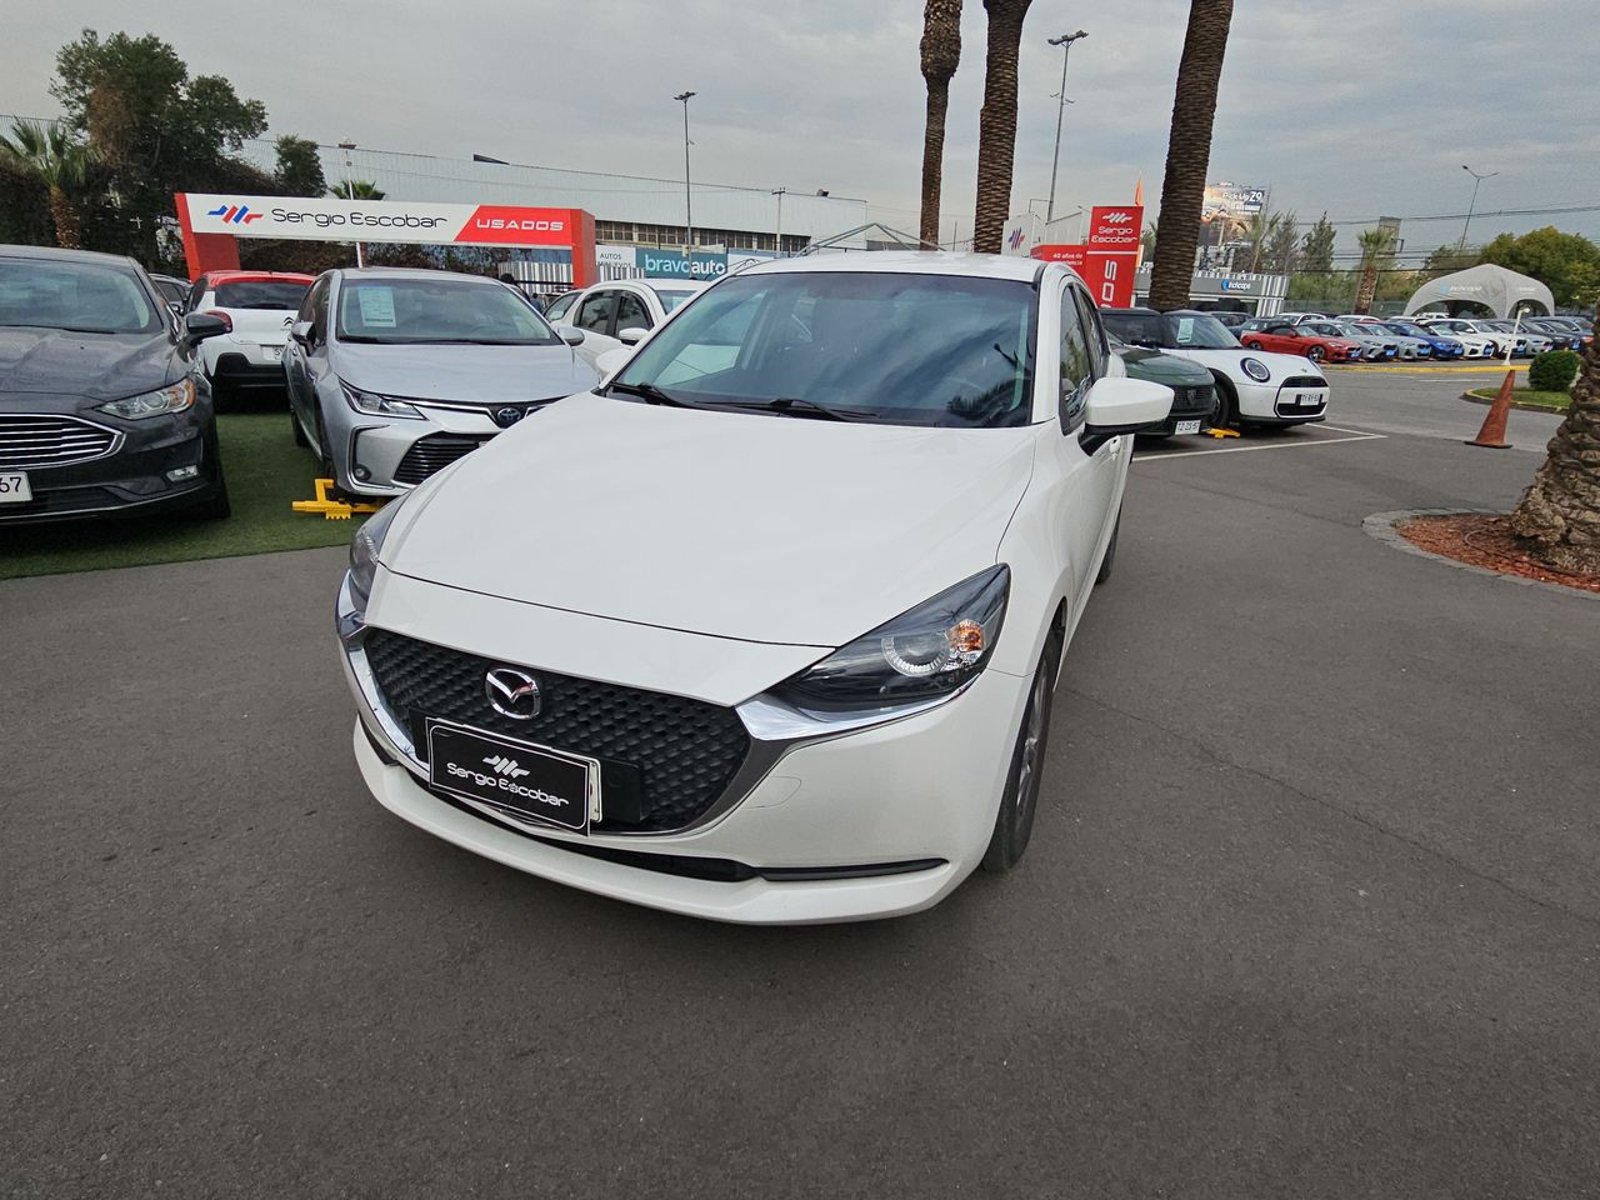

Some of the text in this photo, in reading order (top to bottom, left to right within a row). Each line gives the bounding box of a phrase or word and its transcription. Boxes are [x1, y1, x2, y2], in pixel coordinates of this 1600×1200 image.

[271, 208, 448, 228] Sergio Escobar
[476, 218, 564, 231] USADOS
[1091, 234, 1138, 243] Escobar
[1098, 225, 1134, 236] Sergio
[645, 254, 726, 275] bravoauto
[446, 762, 569, 807] Sergio Escobar
